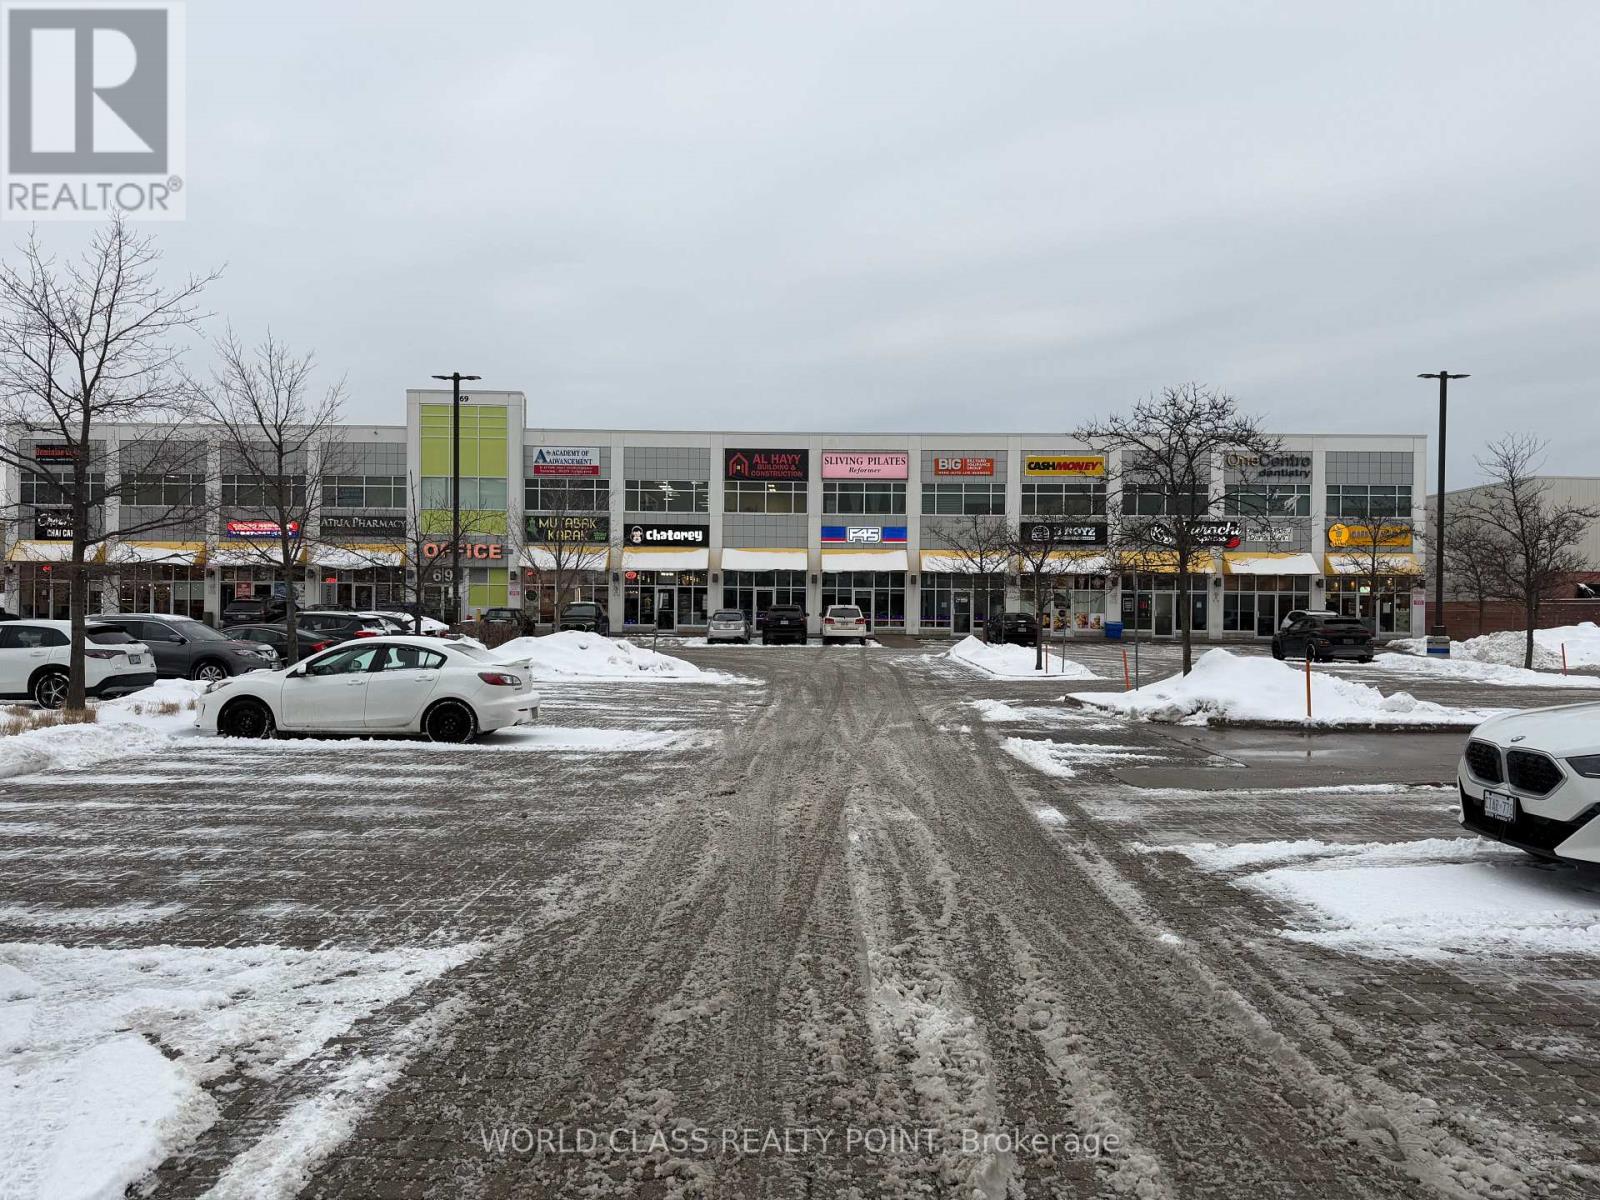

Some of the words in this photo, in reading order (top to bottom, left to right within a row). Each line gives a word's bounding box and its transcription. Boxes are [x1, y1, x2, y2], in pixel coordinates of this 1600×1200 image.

[753, 454, 768, 464] AL
[771, 454, 801, 464] HAYY
[824, 456, 863, 465] SLIVING
[868, 457, 906, 466] PILATES
[939, 459, 962, 470] BIG
[849, 467, 881, 475] Reformer
[1258, 469, 1311, 479] dentistry
[352, 517, 407, 528] PHARMACY
[849, 528, 881, 542] F45
[433, 568, 454, 582] 69
